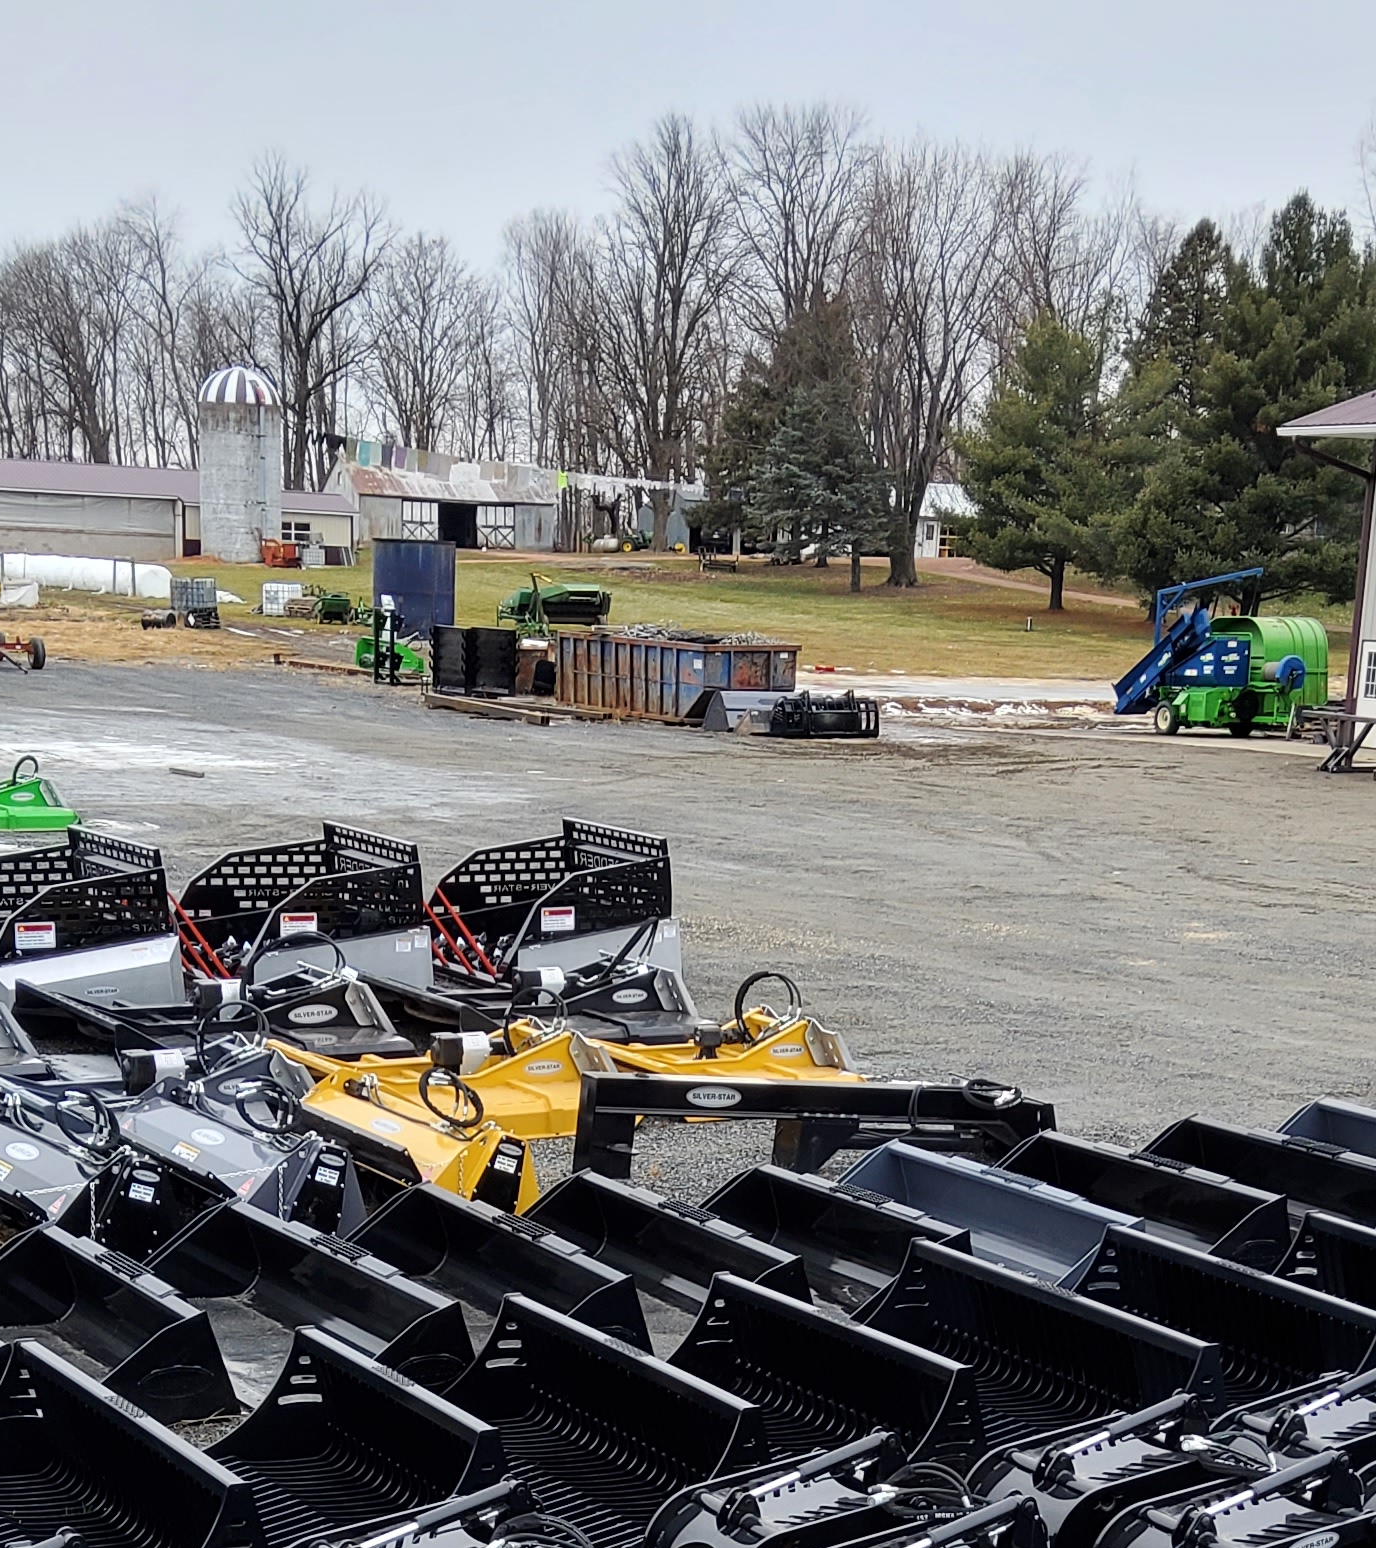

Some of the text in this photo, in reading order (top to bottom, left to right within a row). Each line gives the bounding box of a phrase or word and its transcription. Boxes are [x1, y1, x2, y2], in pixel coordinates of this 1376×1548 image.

[293, 1009, 333, 1019] SILVER-STAR
[527, 1063, 560, 1071] SILVER-STAR
[692, 1093, 736, 1101] SILVER-STAR
